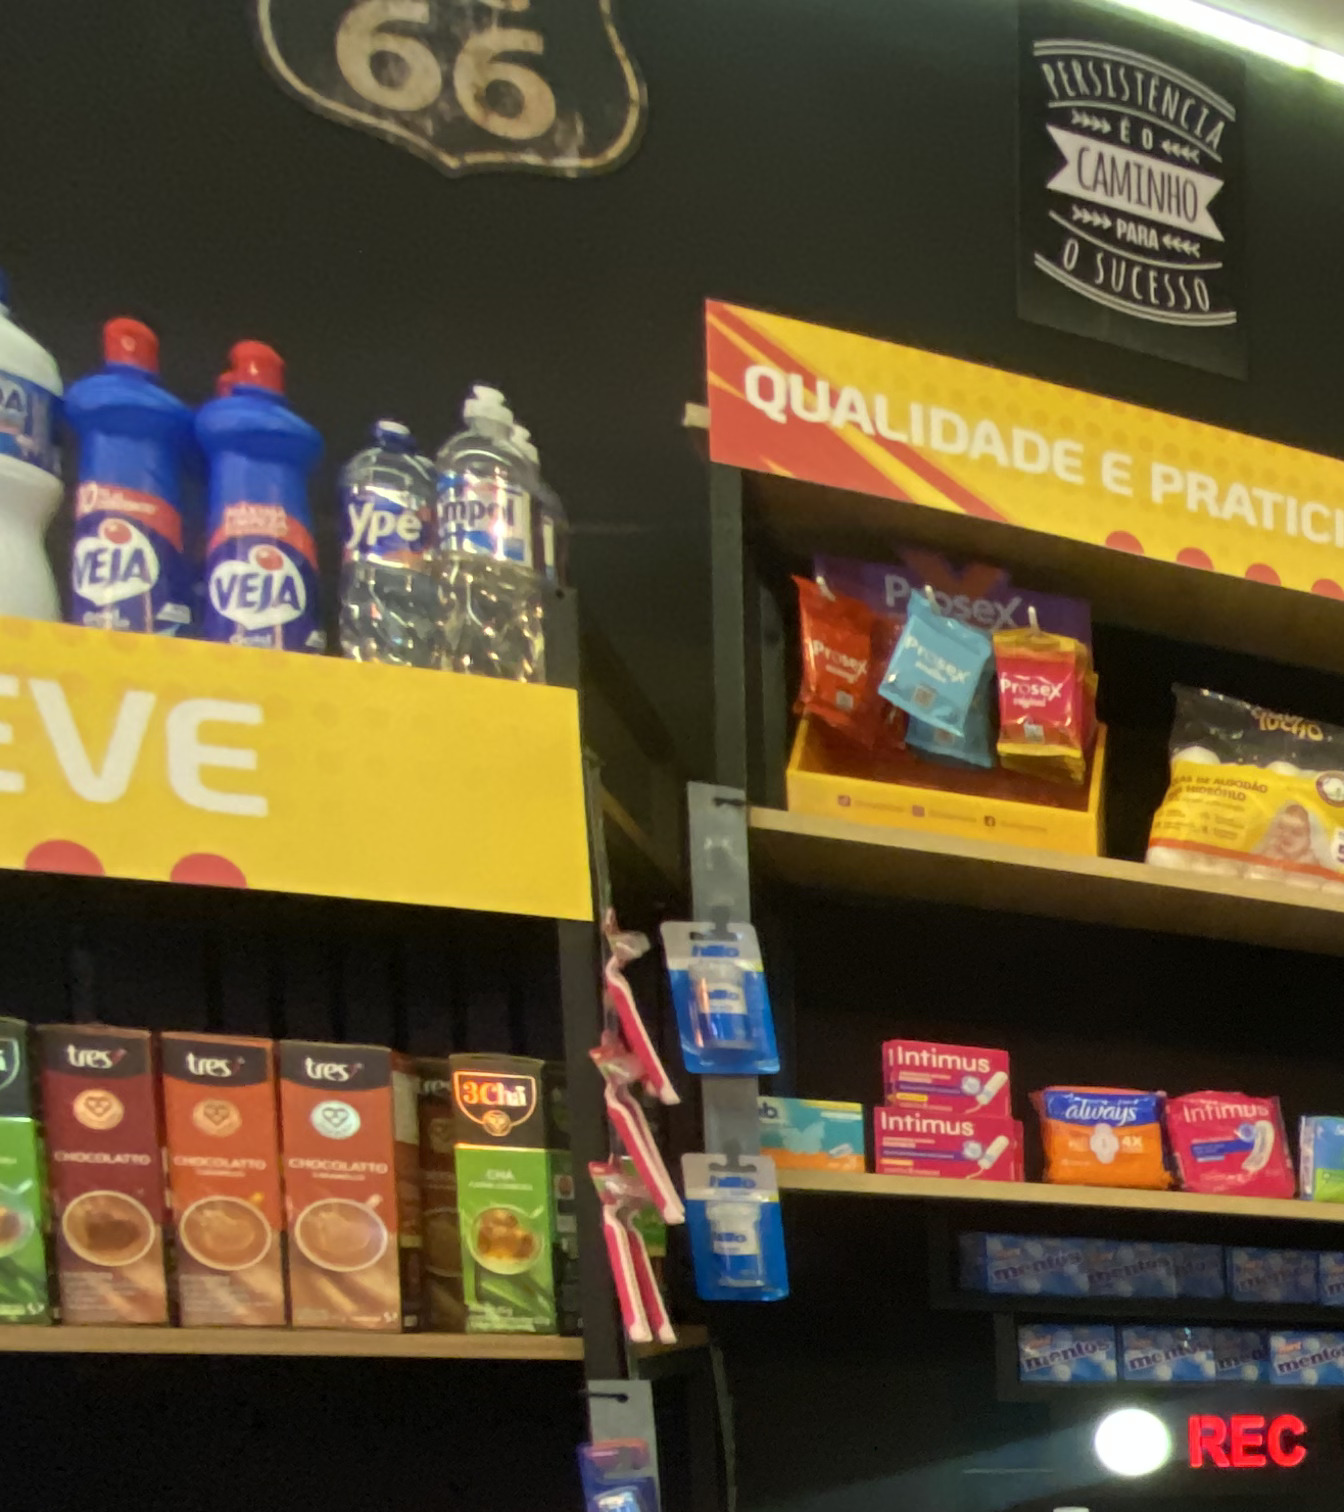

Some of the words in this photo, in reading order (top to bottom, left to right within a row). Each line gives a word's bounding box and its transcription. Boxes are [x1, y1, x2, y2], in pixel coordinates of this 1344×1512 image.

[336, 0, 555, 139] 66
[1142, 130, 1153, 150] O
[1077, 146, 1198, 223] CAMINHO
[1116, 218, 1159, 250] PARA
[1063, 238, 1079, 271] O
[1095, 251, 1210, 312] SUCESSO
[743, 363, 1086, 486] QUALIDADE
[1101, 452, 1133, 497] E
[73, 548, 151, 591] VEJA
[214, 571, 302, 615] VEJA
[884, 573, 1024, 628] Posex
[1000, 671, 1063, 700] Prosex
[0, 676, 270, 818] VE
[66, 1044, 113, 1069] tres
[185, 1052, 233, 1077] tres
[304, 1057, 350, 1082] tres
[896, 1046, 990, 1074] Intimus
[880, 1111, 975, 1138] Intimus
[1065, 1099, 1138, 1127] always
[1183, 1101, 1270, 1124] Intimus
[54, 1150, 152, 1166] CHOCOLATTO
[173, 1156, 267, 1171] CHOCOLATTO
[288, 1158, 389, 1175] CHOCOLATTO
[1024, 1339, 1113, 1372] mentos
[1188, 1413, 1308, 1468] REC
